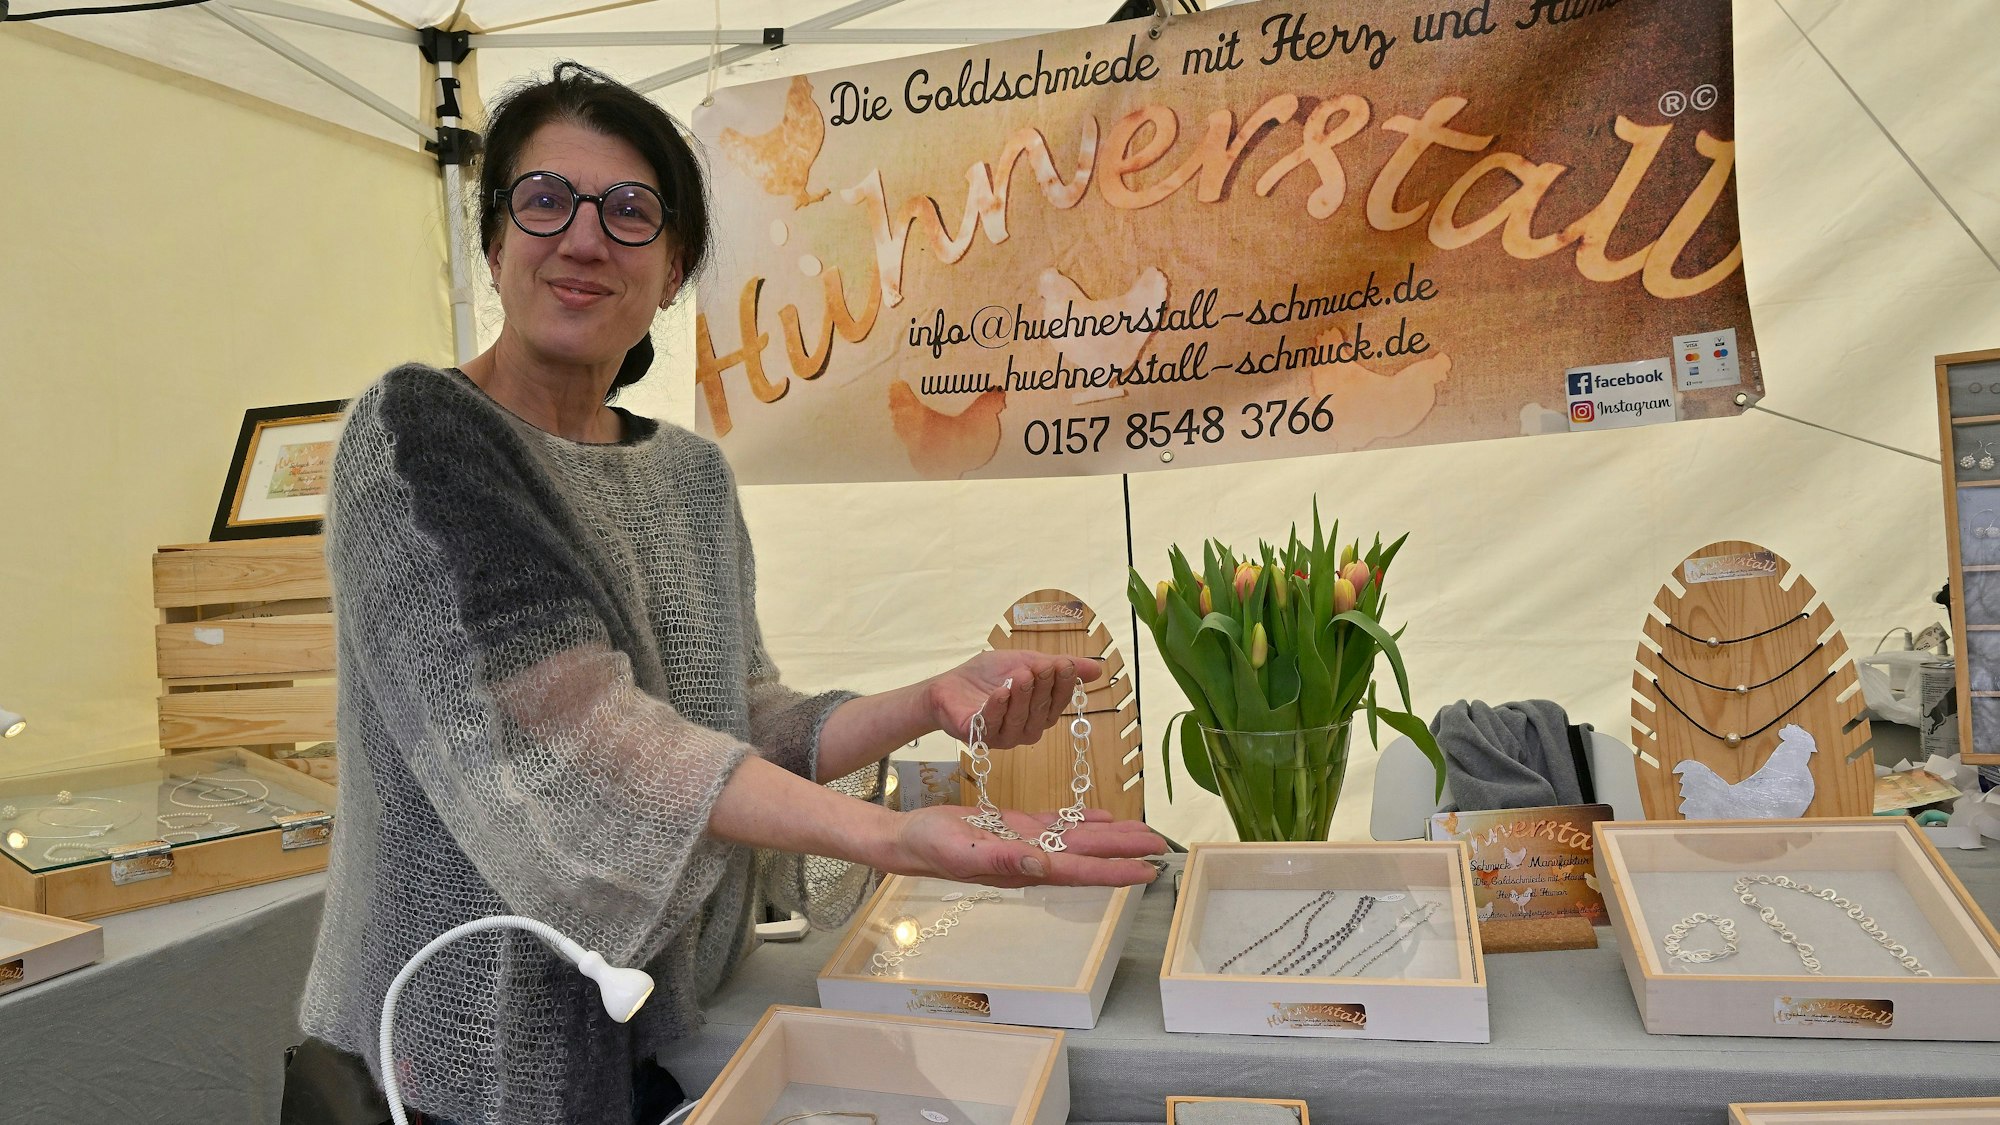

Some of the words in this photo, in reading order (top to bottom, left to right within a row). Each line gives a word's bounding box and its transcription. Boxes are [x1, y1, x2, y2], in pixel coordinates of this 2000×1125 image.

[830, 81, 893, 127] Die
[904, 34, 1160, 115] Goldschmiede
[1182, 24, 1245, 76] mit
[1260, 13, 1397, 70] Herz
[1413, 0, 1498, 44] und
[696, 92, 1743, 438] Hühnerstall
[1594, 369, 1664, 389] facebook
[1597, 398, 1672, 417] Instagram
[1024, 416, 1110, 456] 0157
[1125, 405, 1225, 450] 8548
[1240, 394, 1335, 441] 3766
[1461, 819, 1593, 854] hnersta
[1470, 858, 1512, 872] Schmuck
[1528, 854, 1591, 870] Manufaktur
[1473, 877, 1490, 887] Die
[1491, 874, 1545, 886] Goldschmiede
[1547, 874, 1560, 883] mit
[1495, 889, 1520, 901] Herz
[1523, 888, 1537, 898] und
[1539, 887, 1568, 898] Humor
